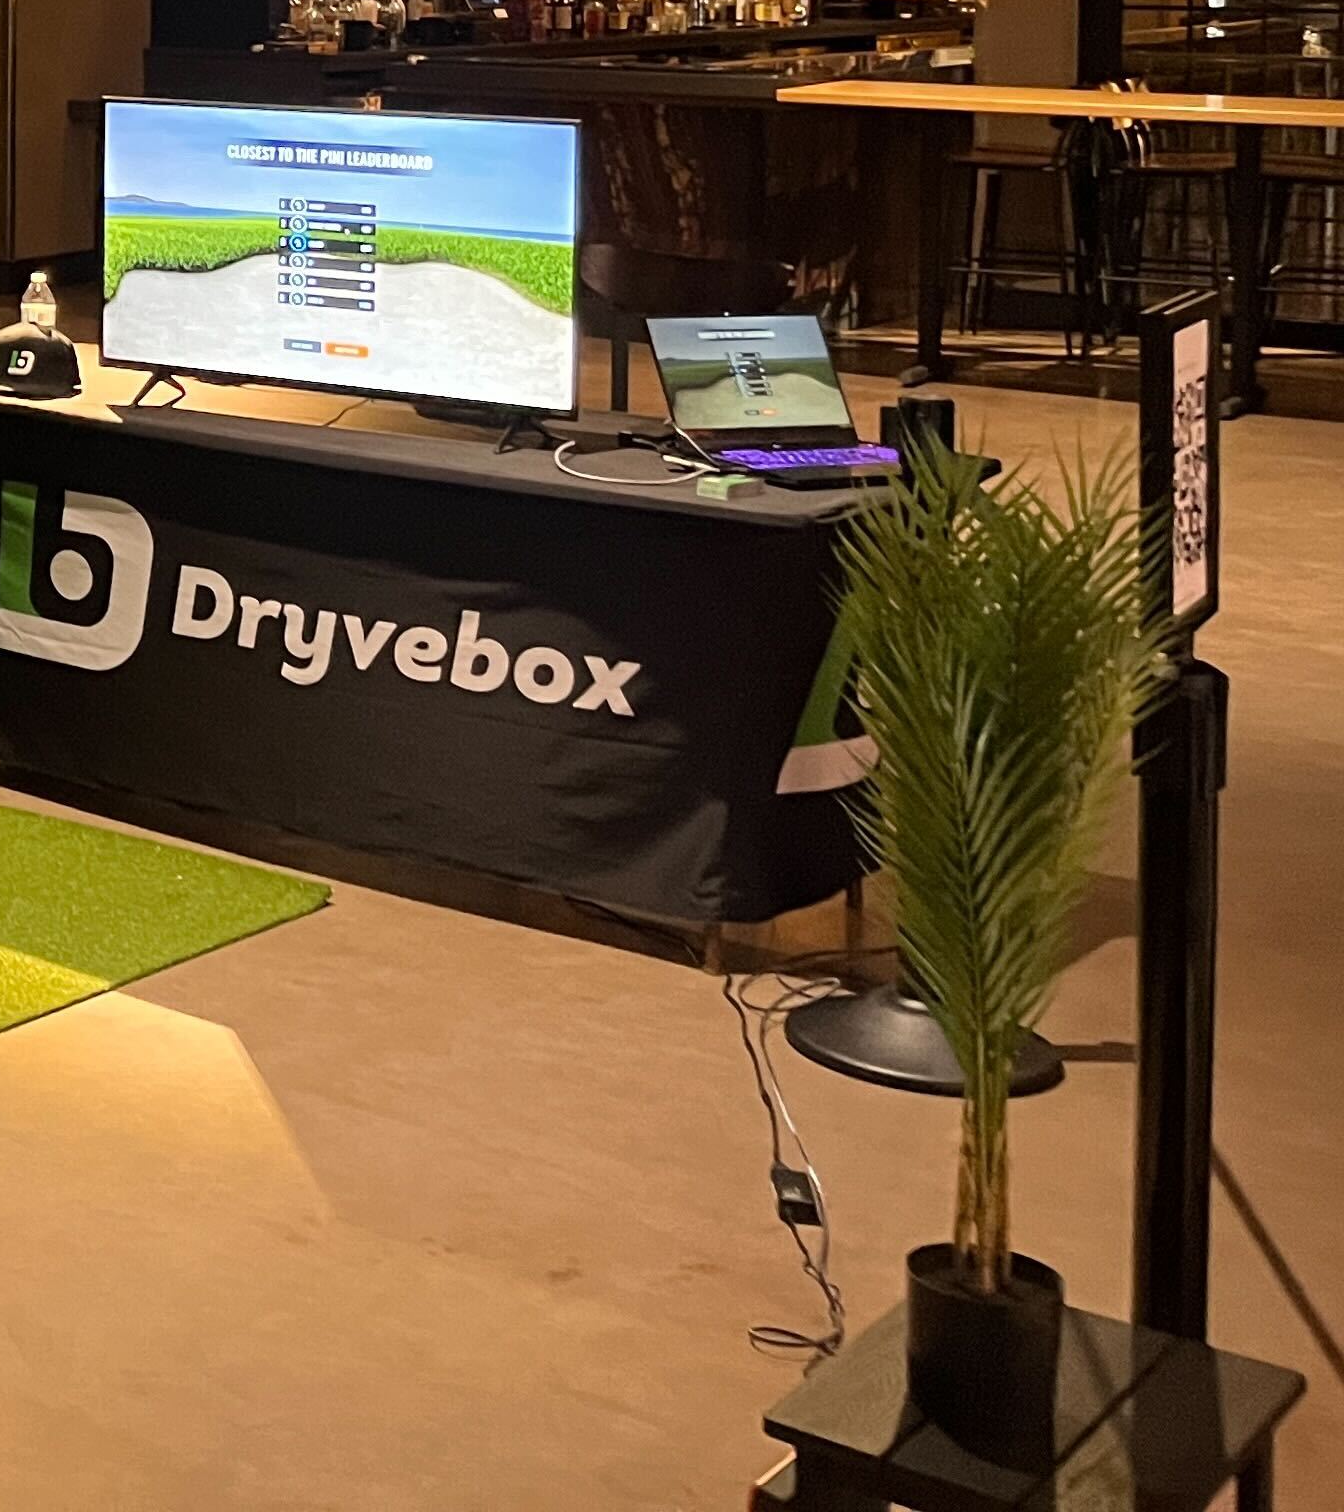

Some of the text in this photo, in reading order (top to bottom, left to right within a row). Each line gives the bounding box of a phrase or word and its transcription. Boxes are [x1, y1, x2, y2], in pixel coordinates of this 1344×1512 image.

[226, 144, 276, 161] CLOSEST
[278, 146, 293, 163] TO
[296, 148, 318, 164] THE
[346, 151, 433, 171] LEADERBOARD
[171, 564, 643, 718] Dryvebox
